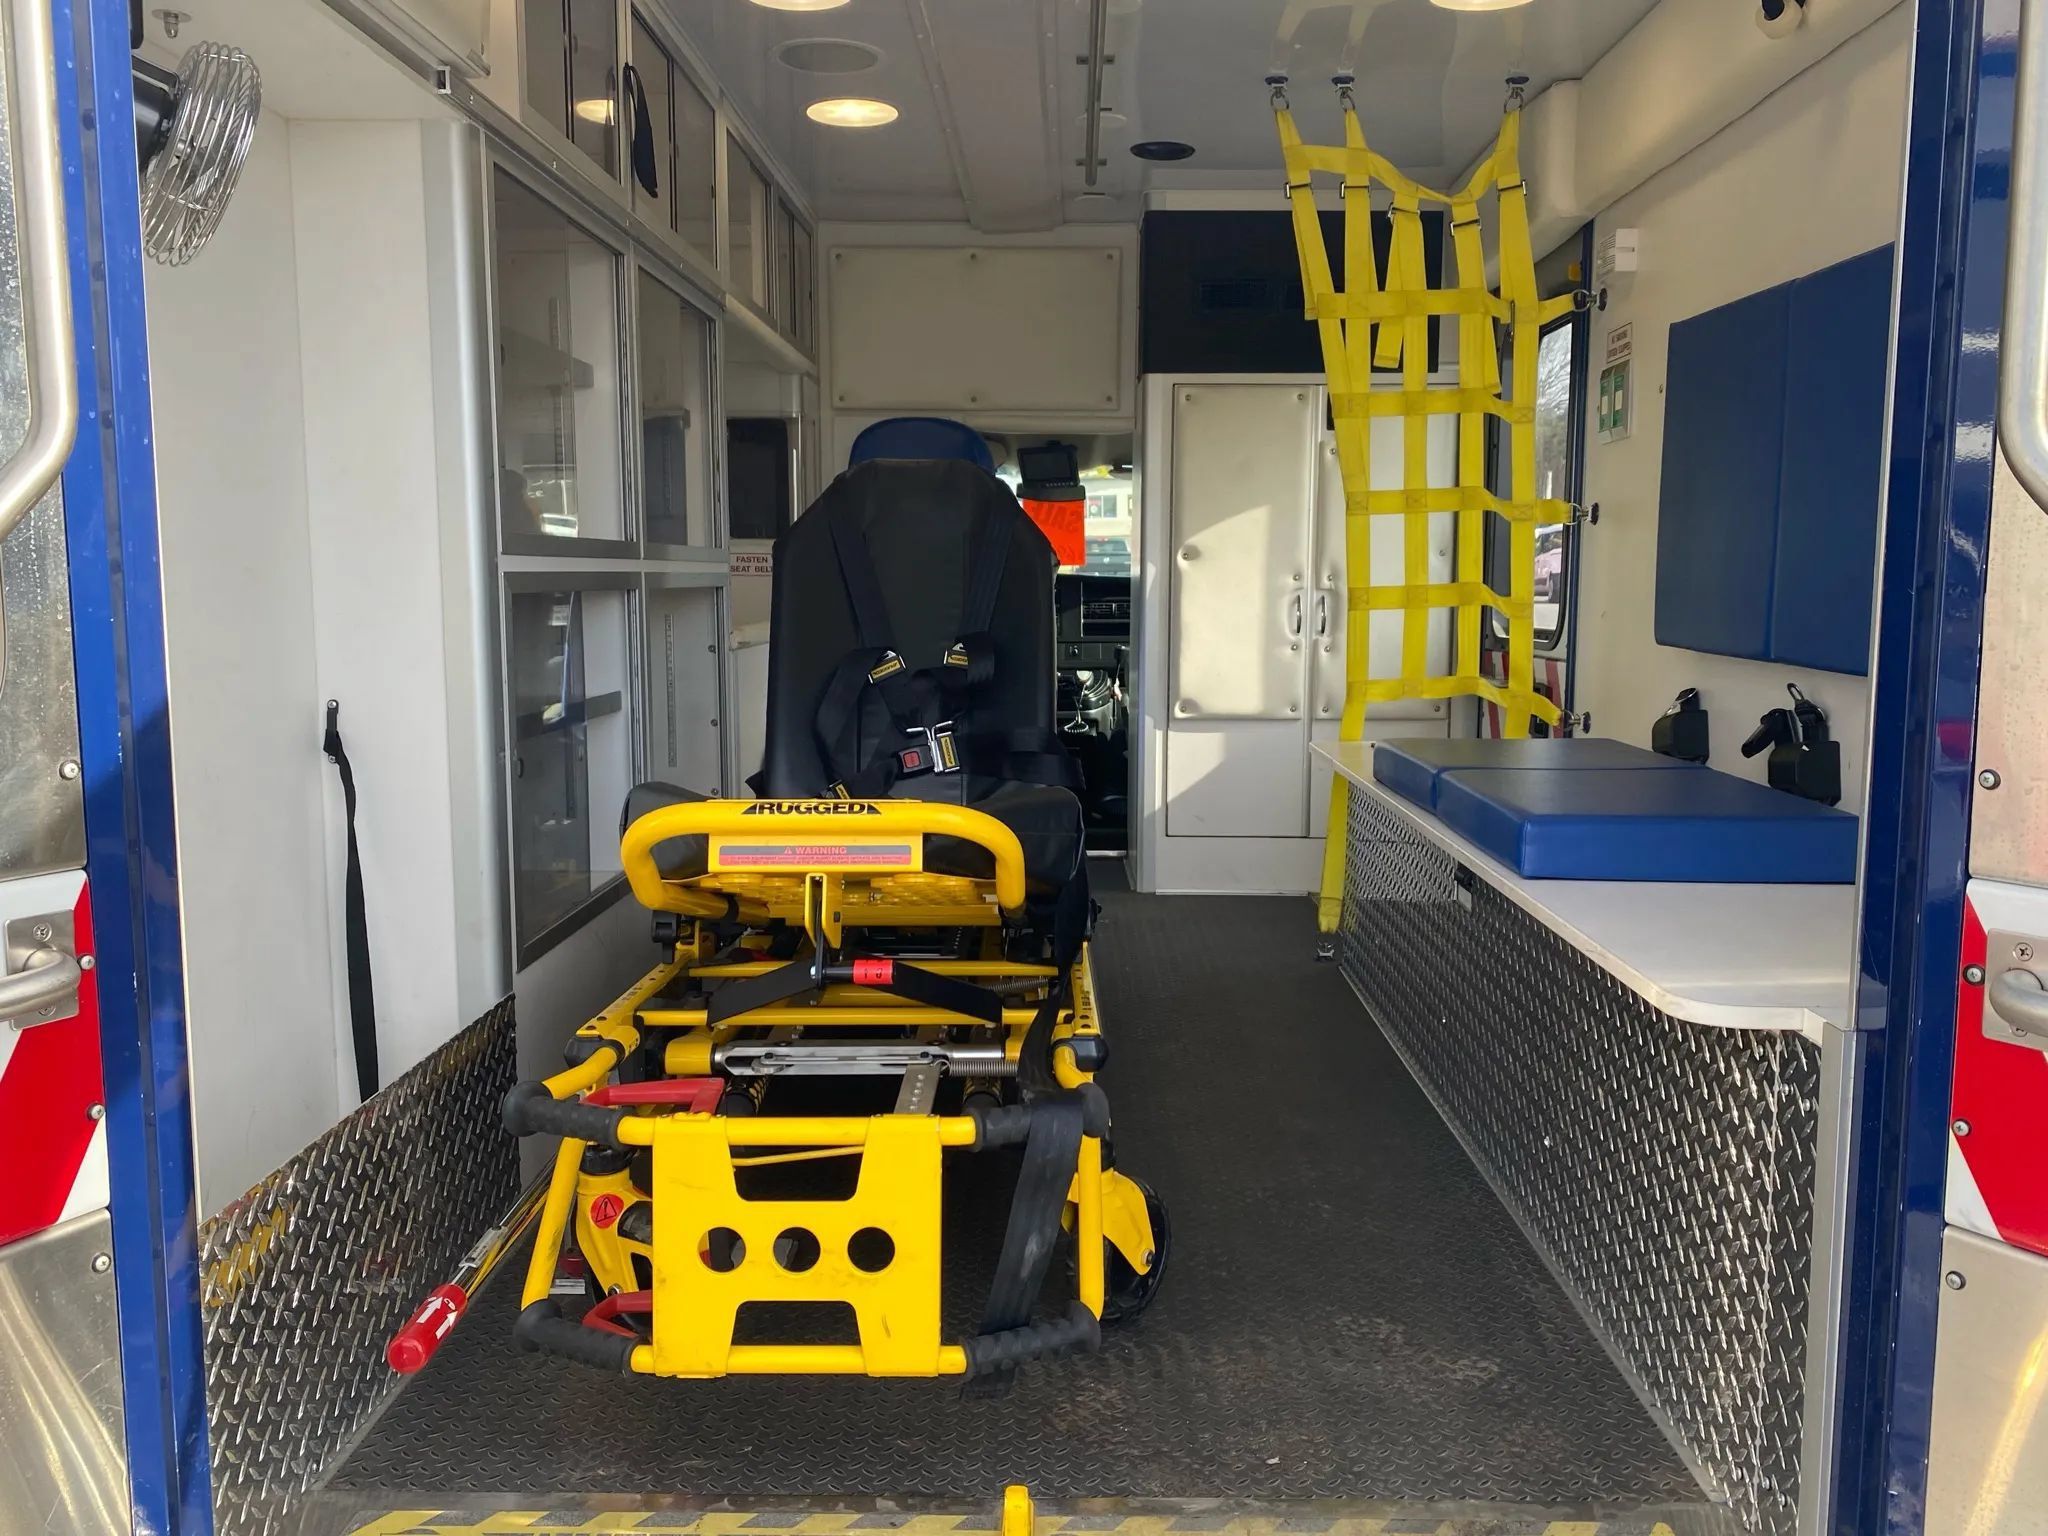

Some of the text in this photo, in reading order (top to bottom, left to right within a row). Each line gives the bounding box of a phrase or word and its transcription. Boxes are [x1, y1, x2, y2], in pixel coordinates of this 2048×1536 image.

[736, 555, 768, 564] FASTEN
[730, 565, 751, 573] SEAT
[759, 801, 867, 815] RUGGED
[795, 846, 848, 855] WARNING
